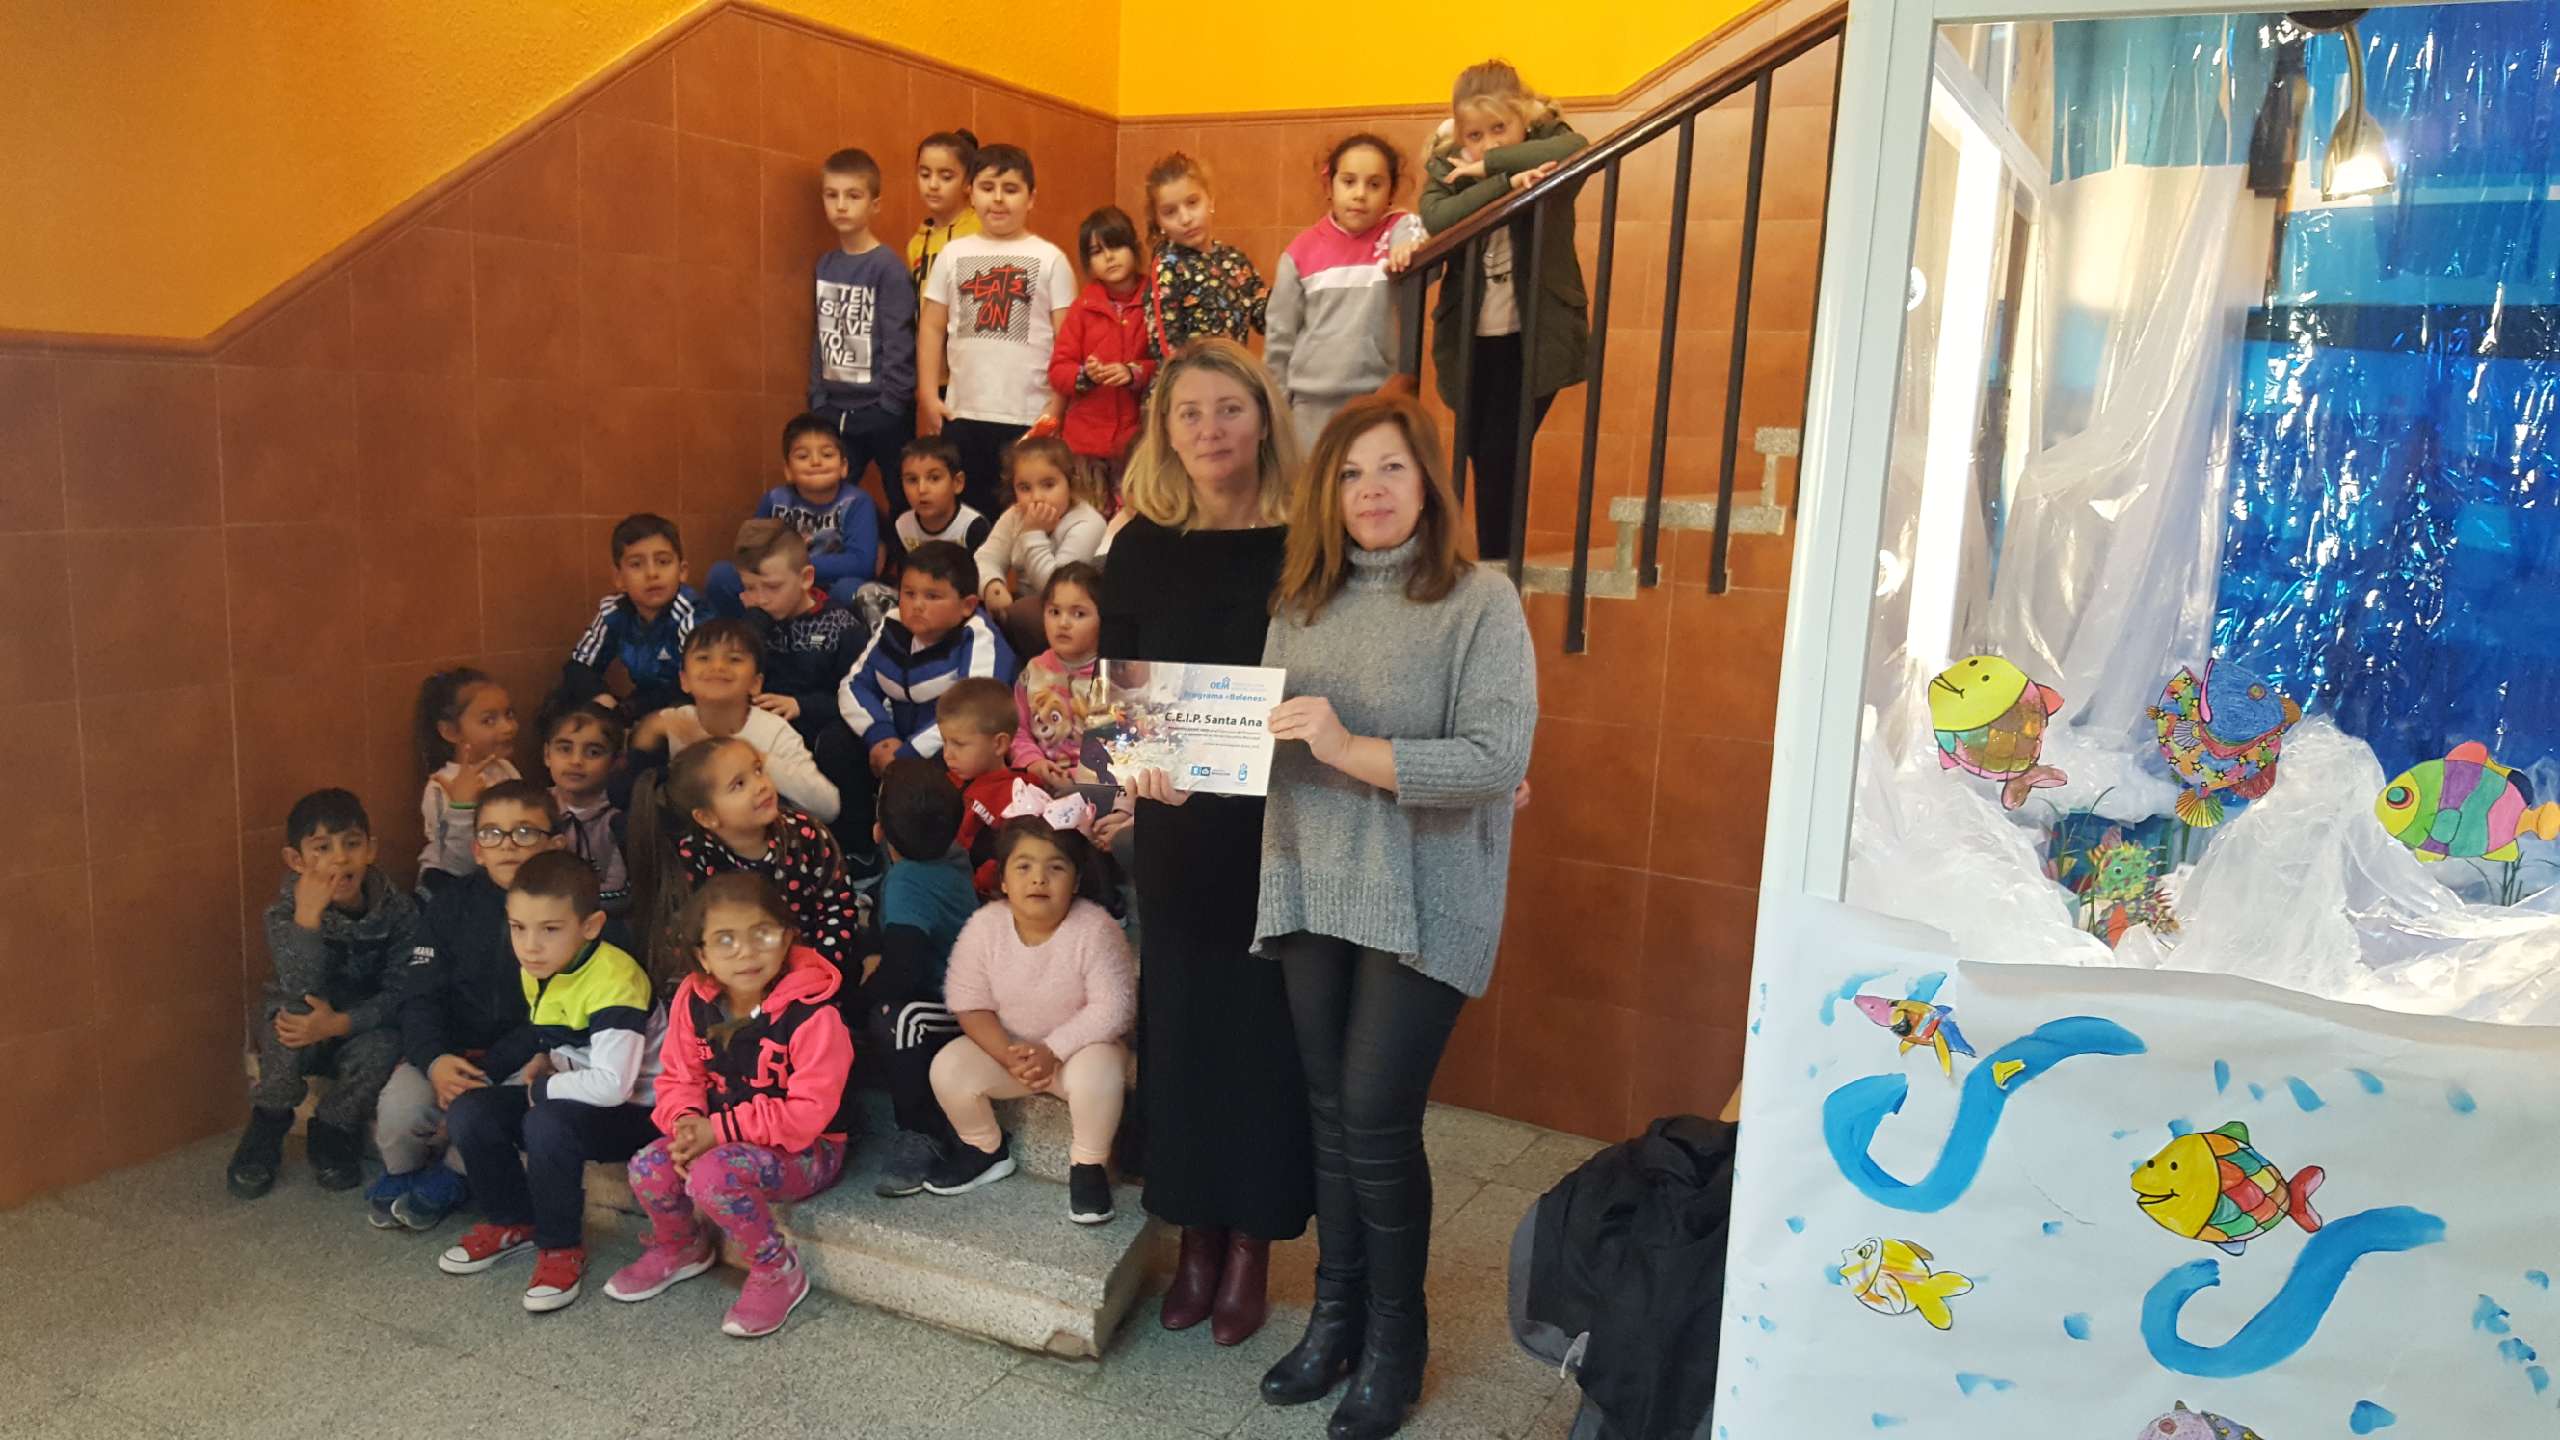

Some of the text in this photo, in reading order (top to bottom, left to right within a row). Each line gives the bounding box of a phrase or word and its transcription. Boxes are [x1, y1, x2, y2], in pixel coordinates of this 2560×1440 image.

[839, 285, 875, 304] TEN
[1164, 712, 1263, 727] C.E.I.P. Santa Ana
